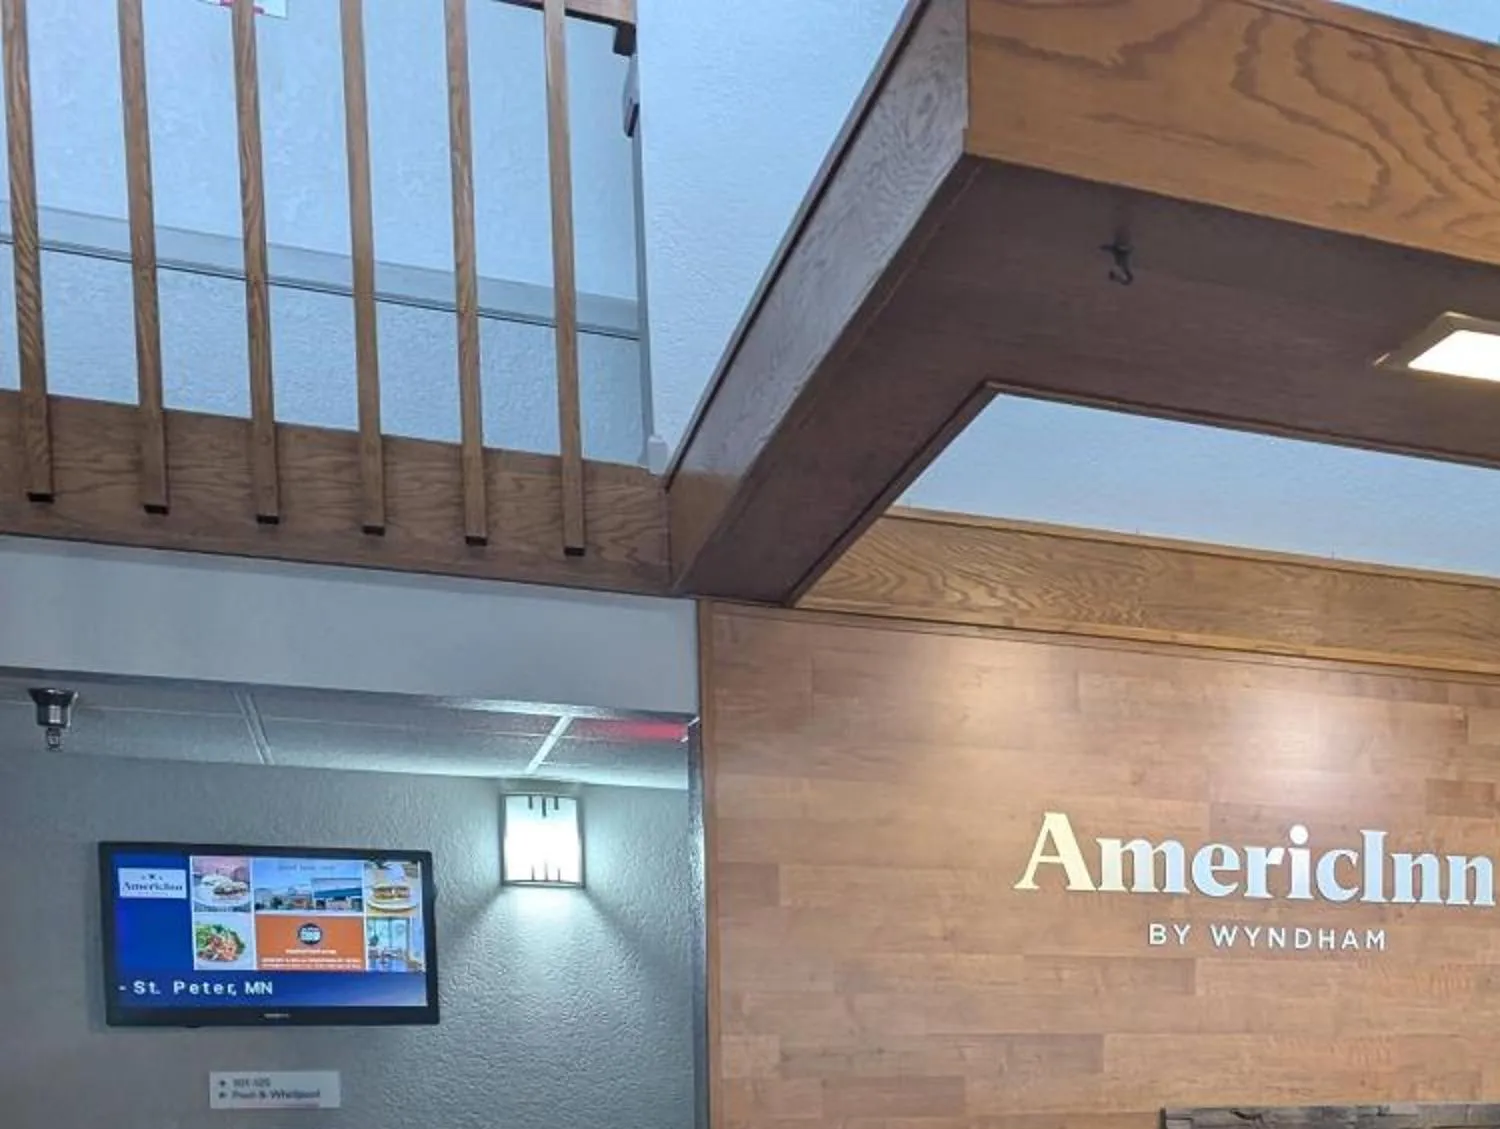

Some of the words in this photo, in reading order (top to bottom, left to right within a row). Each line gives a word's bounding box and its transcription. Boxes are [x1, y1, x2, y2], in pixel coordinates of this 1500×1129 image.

[1013, 811, 1496, 907] AmericInn
[1148, 922, 1192, 946] BY
[1210, 925, 1387, 950] WYNDHAM
[133, 980, 161, 995] St.
[173, 980, 238, 996] Peter,
[244, 980, 273, 995] MN
